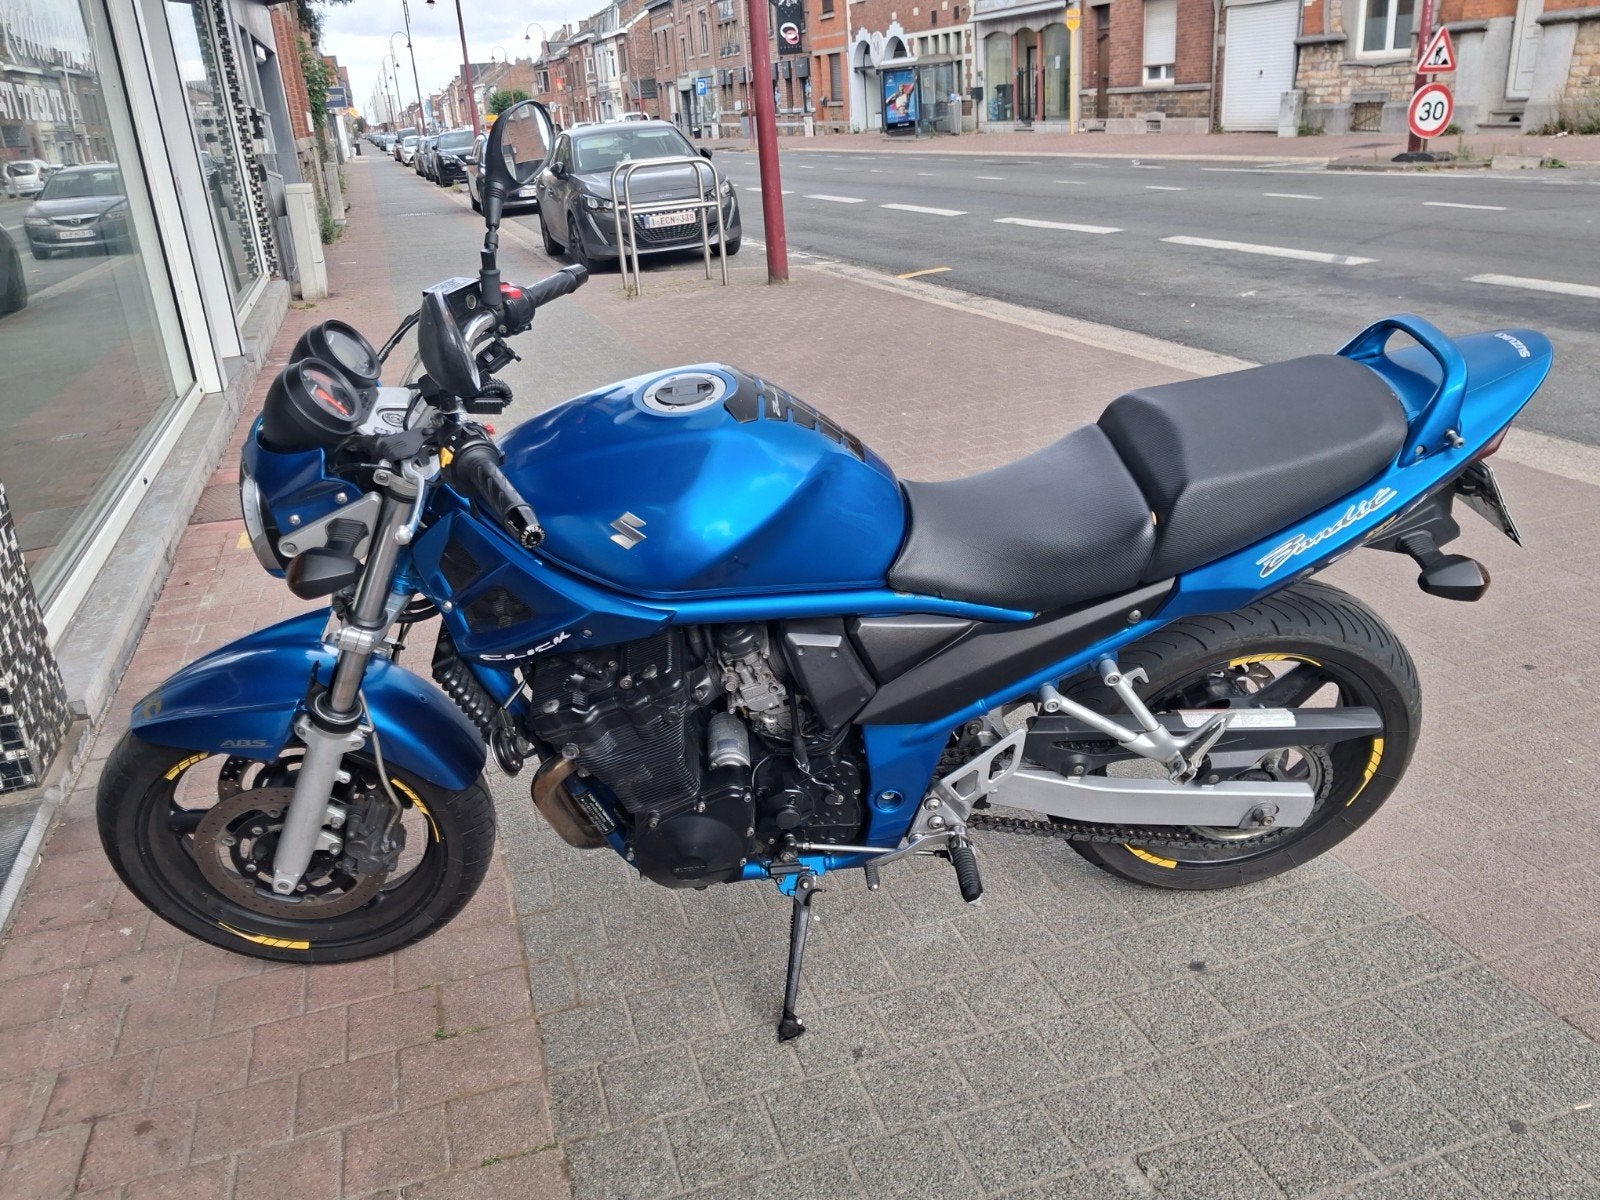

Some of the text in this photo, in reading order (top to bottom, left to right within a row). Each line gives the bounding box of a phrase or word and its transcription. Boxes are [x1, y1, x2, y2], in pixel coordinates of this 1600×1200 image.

[697, 81, 705, 94] P
[1419, 101, 1445, 121] 30
[1494, 332, 1531, 358] SUZUKI
[1255, 486, 1398, 578] Bandit
[220, 739, 269, 749] ABS
